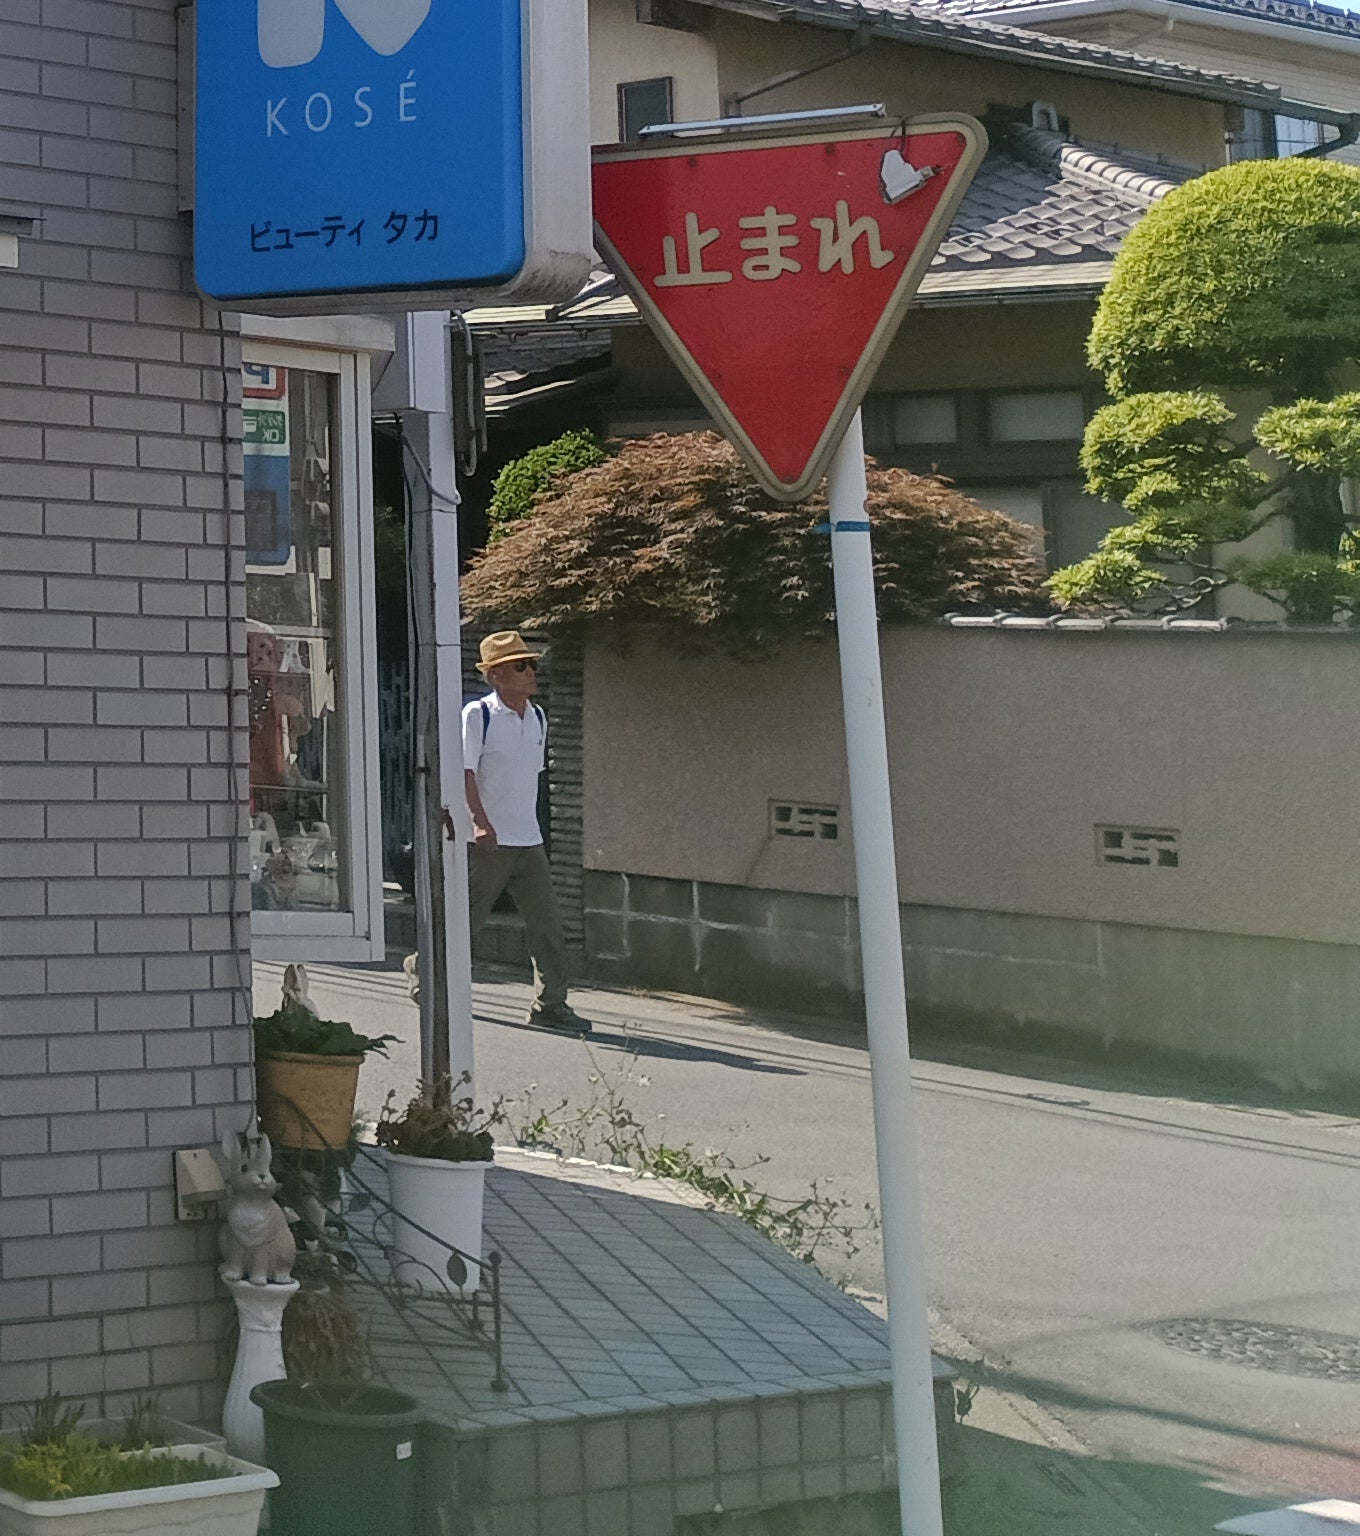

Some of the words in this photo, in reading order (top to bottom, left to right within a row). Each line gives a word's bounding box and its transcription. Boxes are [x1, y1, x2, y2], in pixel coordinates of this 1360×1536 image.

[265, 69, 419, 139] KOSÉ
[249, 214, 364, 254] ビューティ
[385, 208, 440, 244] タカ
[653, 198, 896, 288] 止まれ
